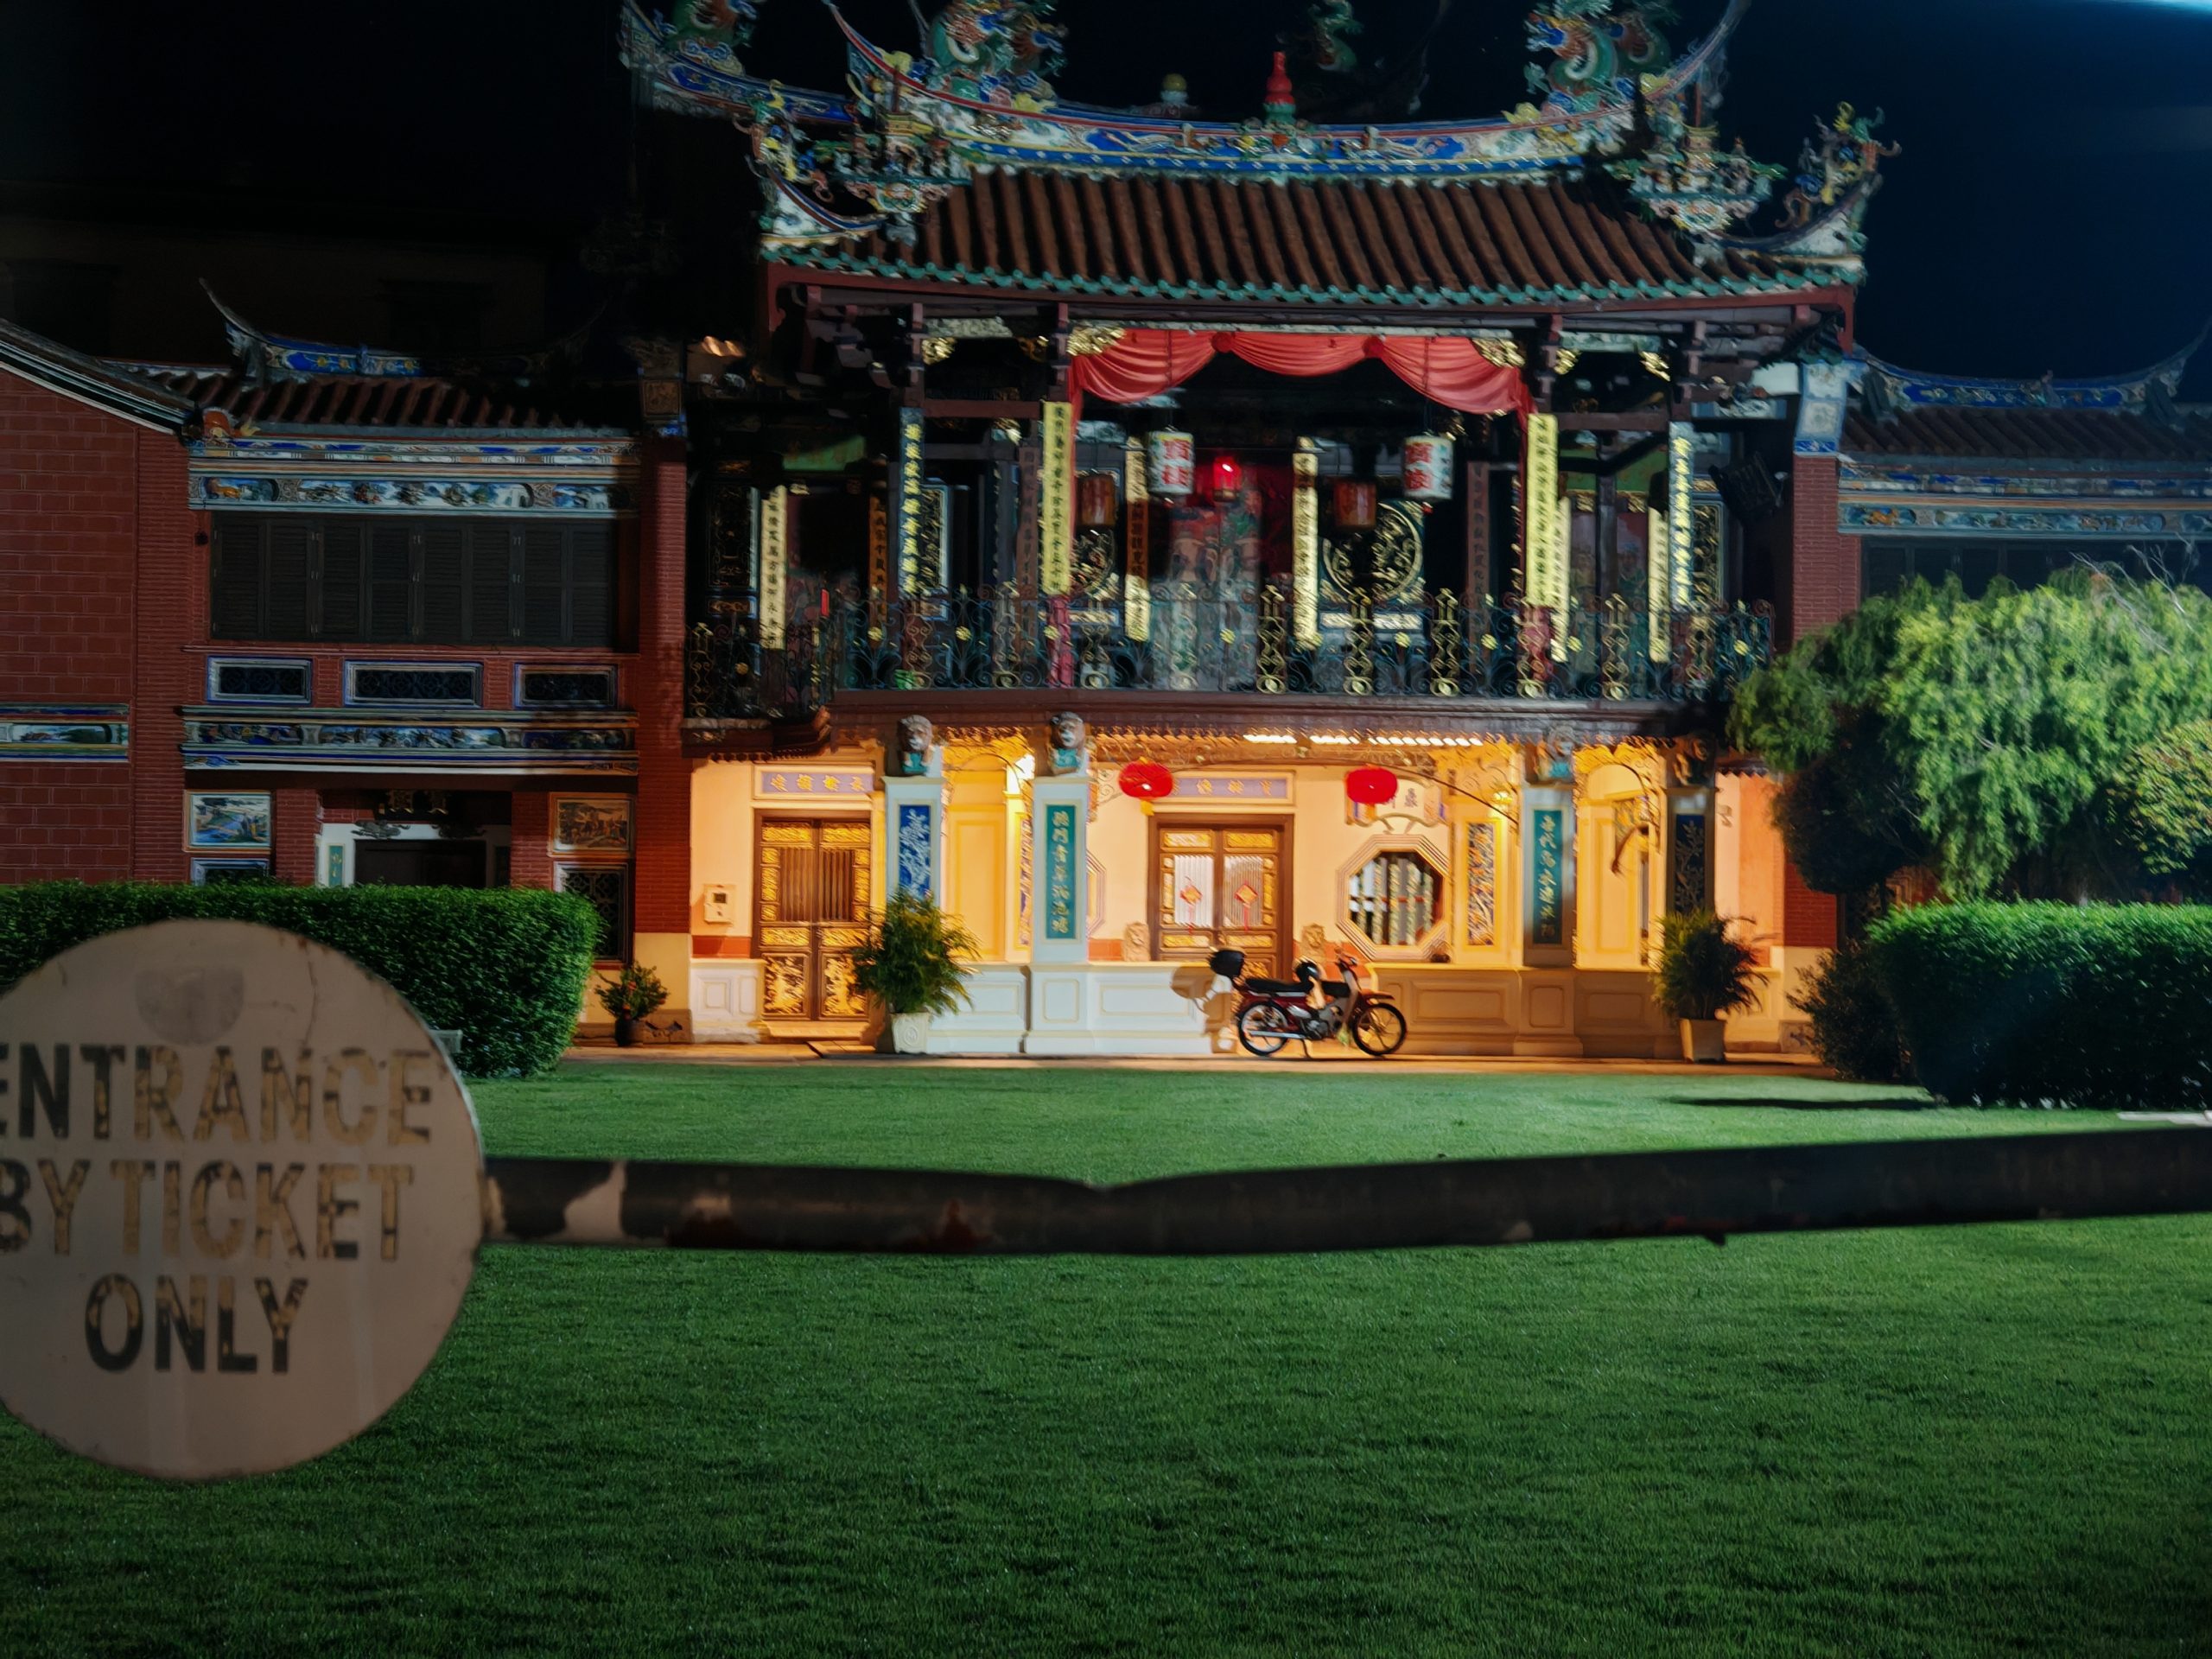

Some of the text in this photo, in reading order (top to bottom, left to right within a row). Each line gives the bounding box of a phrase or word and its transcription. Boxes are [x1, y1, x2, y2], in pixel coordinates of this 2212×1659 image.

[0, 1043, 431, 1144] NTRANCE
[0, 1159, 415, 1262] BY TICKET
[86, 1273, 308, 1374] ONLY
